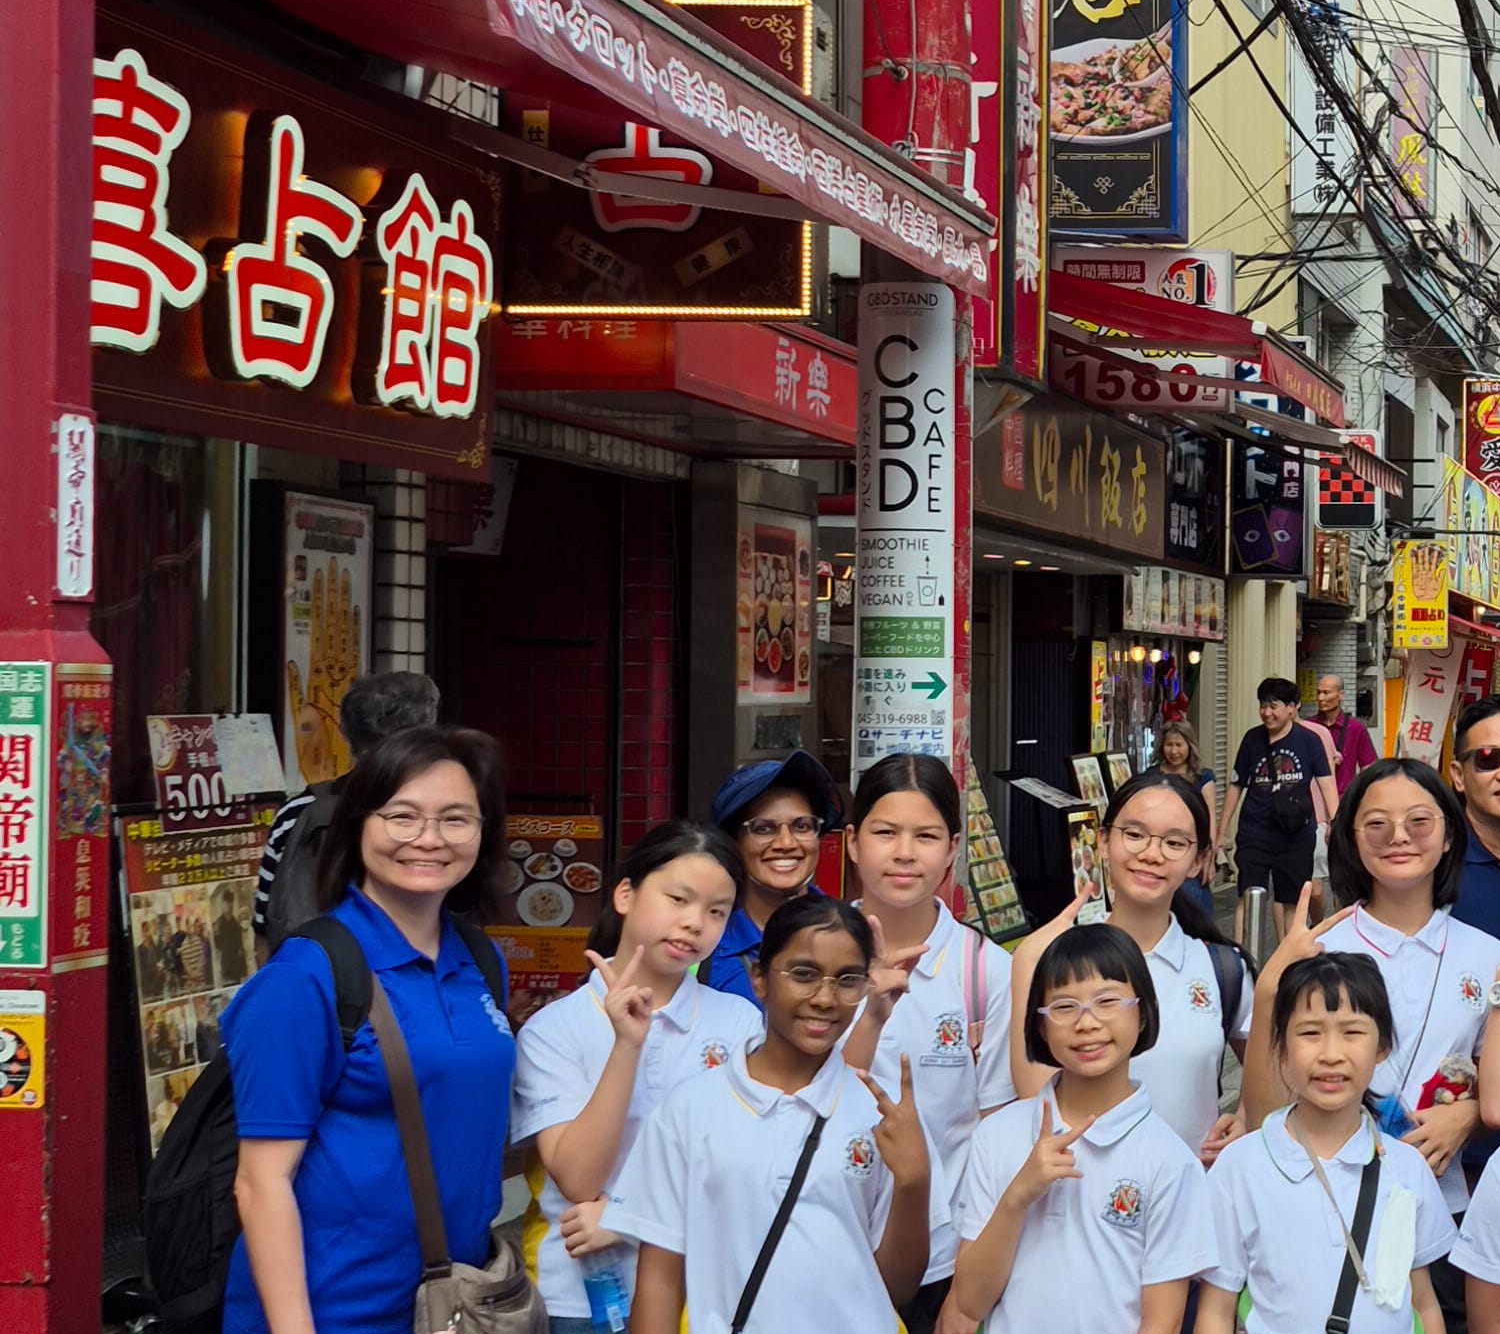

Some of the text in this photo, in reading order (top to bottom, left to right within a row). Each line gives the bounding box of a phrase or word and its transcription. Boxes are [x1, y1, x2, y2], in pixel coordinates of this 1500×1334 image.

[874, 334, 920, 512] CBD
[922, 387, 947, 513] CAFE
[861, 537, 929, 551] SMOOTHIE
[861, 556, 895, 569] JUICE
[861, 575, 905, 588] COFFEE
[861, 593, 903, 606] VEGAN
[858, 713, 928, 725] 045-319-6988
